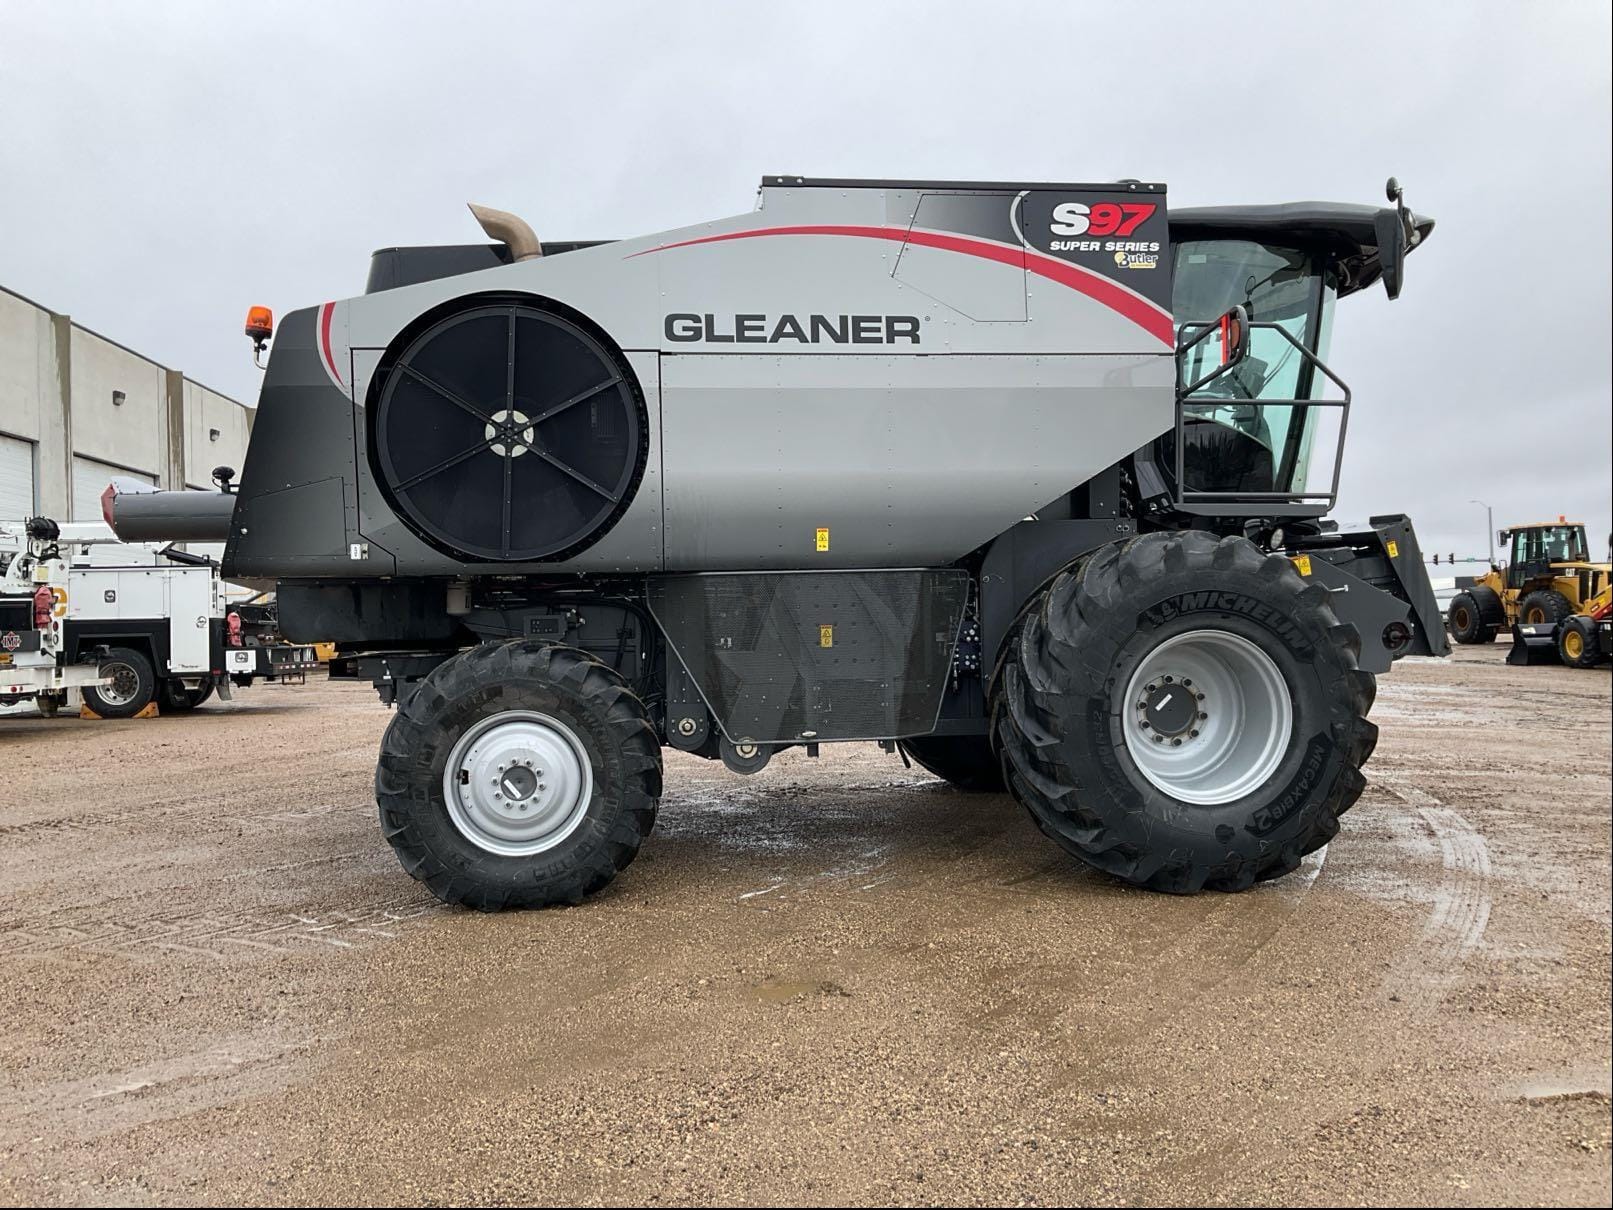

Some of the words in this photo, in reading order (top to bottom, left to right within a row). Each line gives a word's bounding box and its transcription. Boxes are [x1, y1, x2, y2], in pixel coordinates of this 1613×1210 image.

[1050, 202, 1157, 237] S97
[1049, 241, 1101, 252] SUPER
[1104, 242, 1160, 252] SERIES
[1116, 252, 1159, 268] Butler
[664, 313, 921, 344] GLEANER
[1181, 591, 1310, 650] MICHELIN
